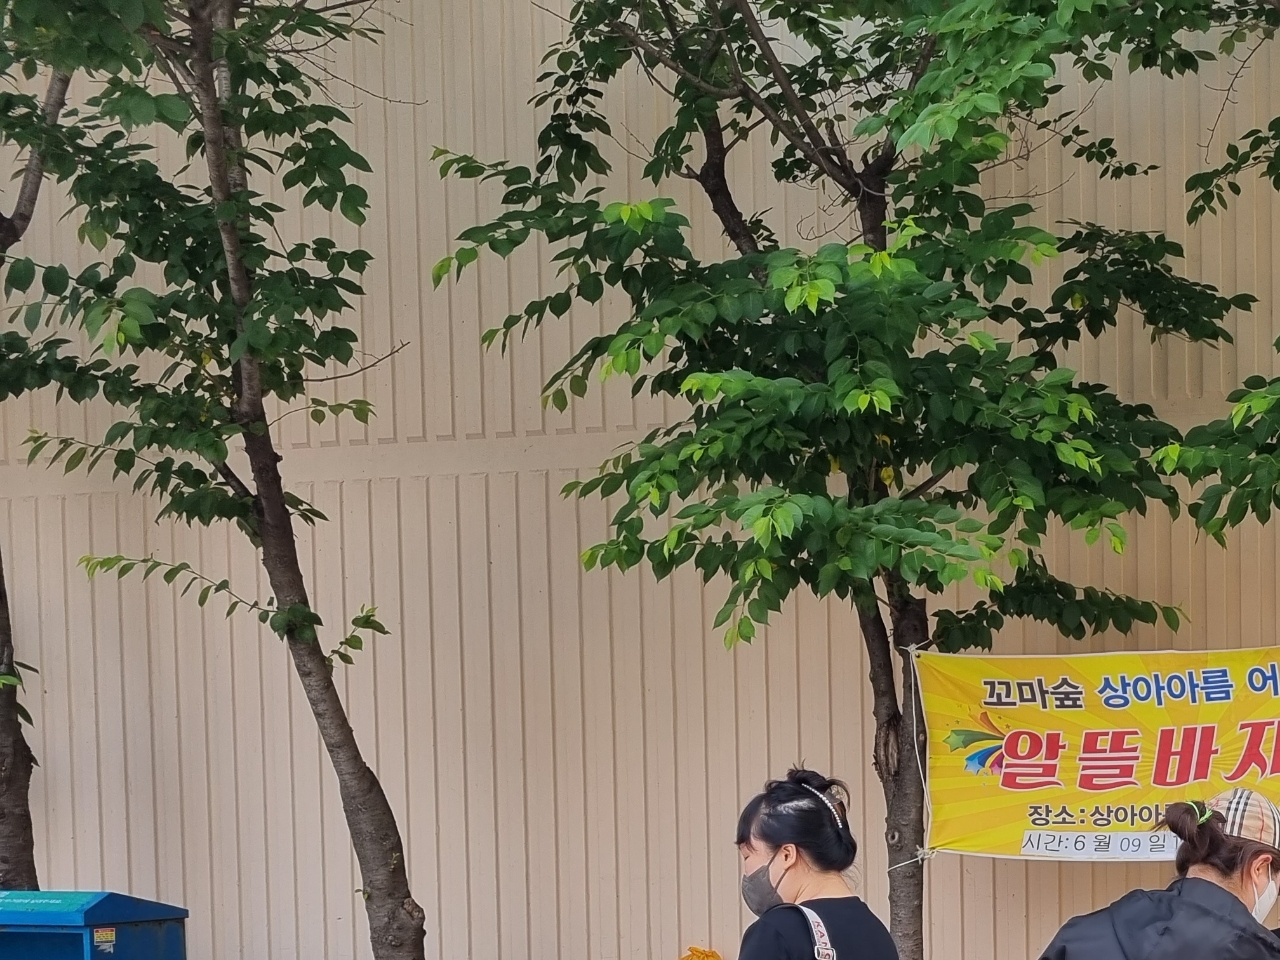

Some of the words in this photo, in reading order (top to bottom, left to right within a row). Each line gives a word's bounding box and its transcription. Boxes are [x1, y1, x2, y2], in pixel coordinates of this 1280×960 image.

[983, 676, 1085, 710] 꼬마숲
[1098, 668, 1234, 709] 상아아름
[1027, 804, 1168, 827] 장소:상아아
